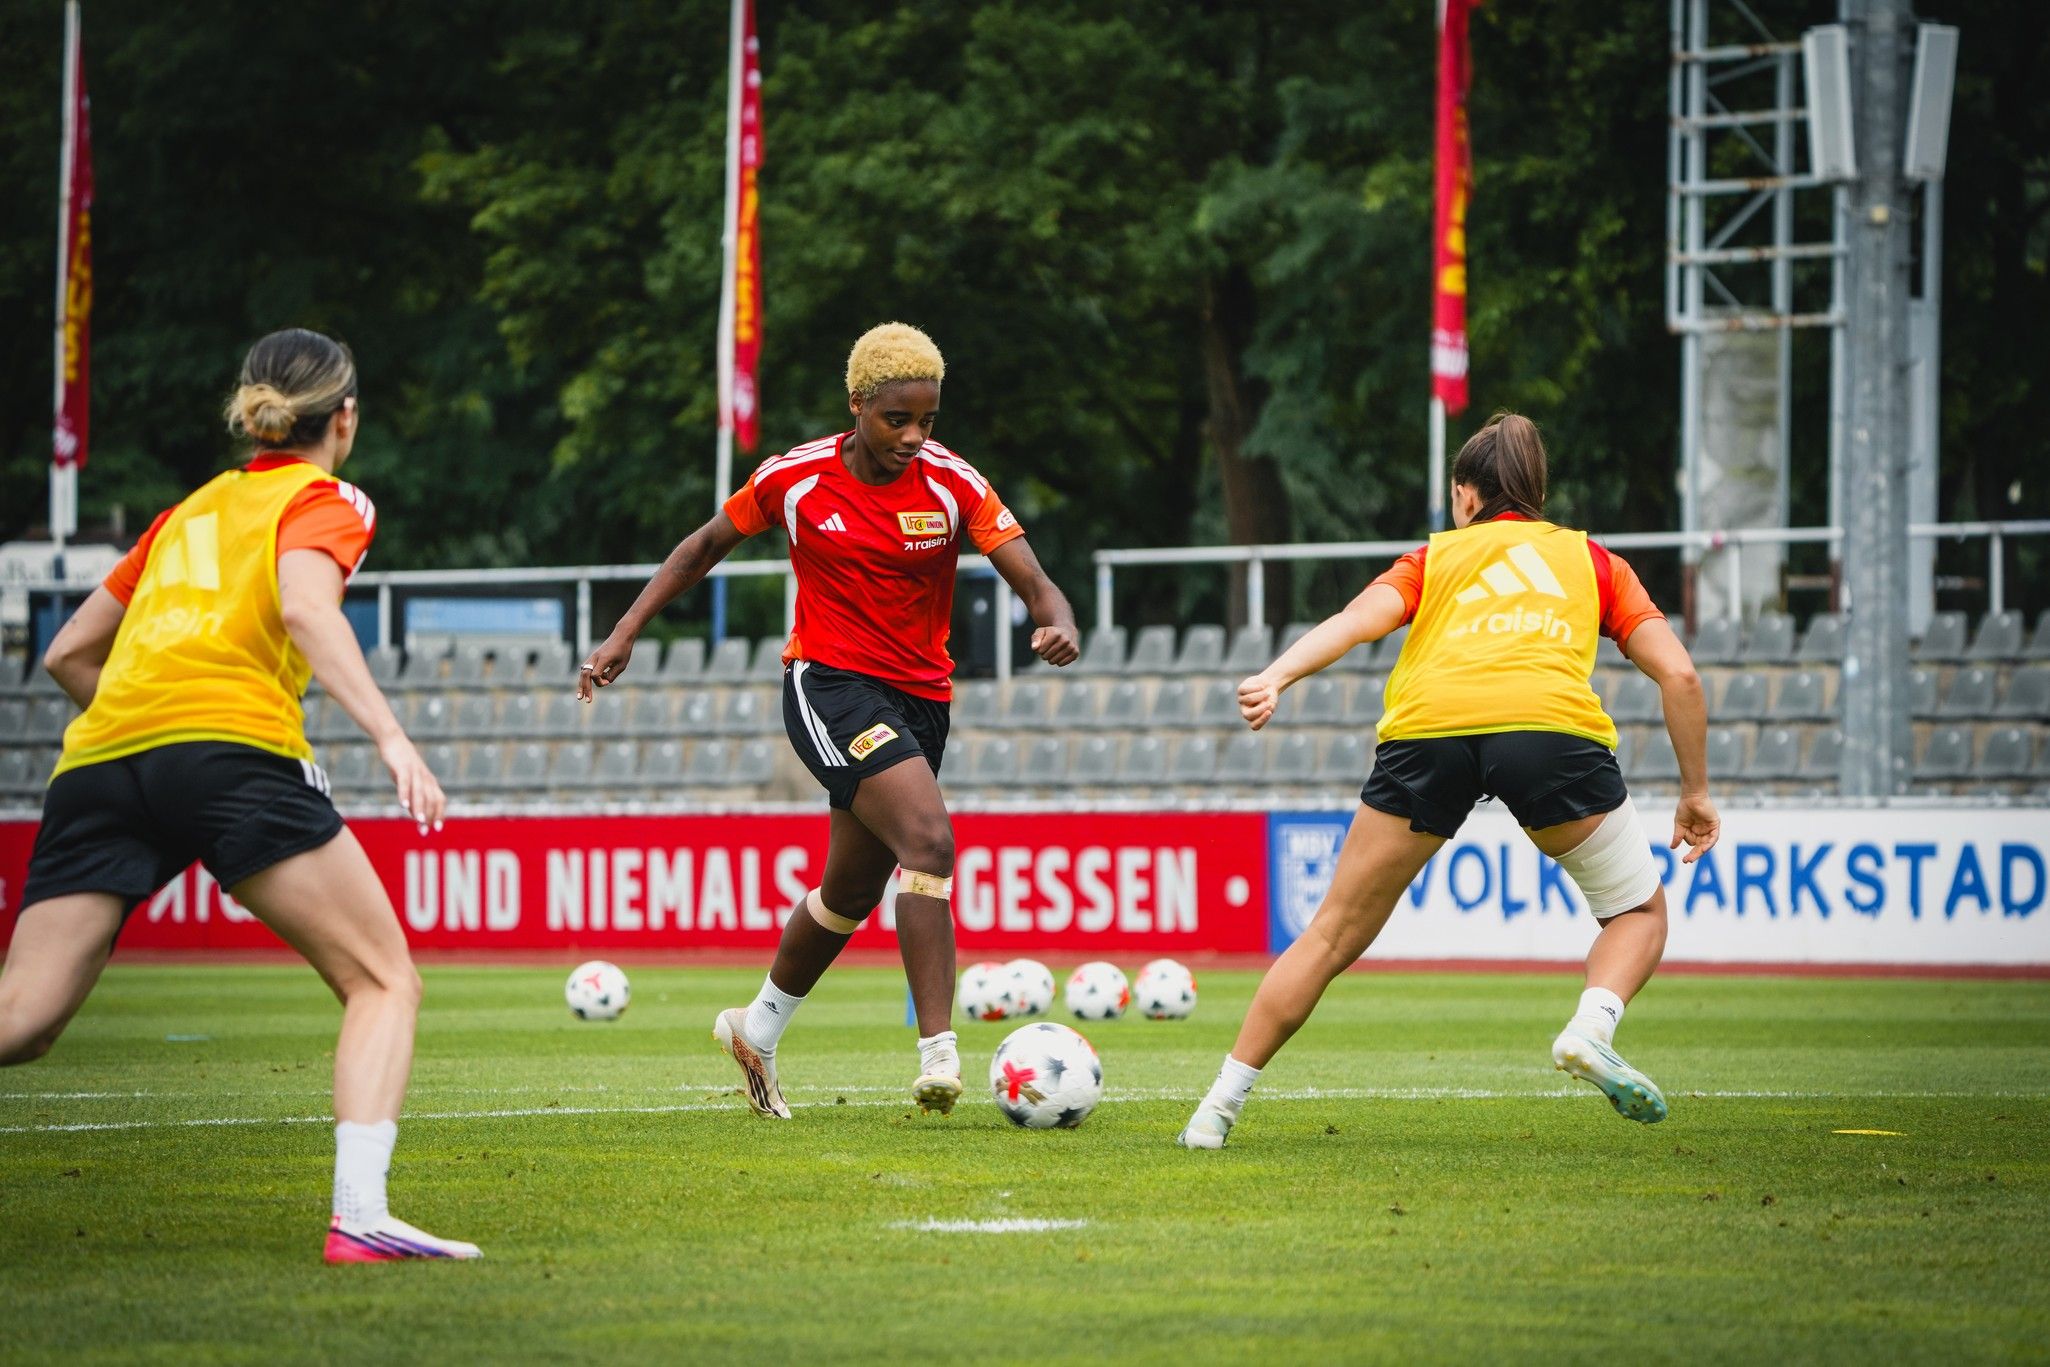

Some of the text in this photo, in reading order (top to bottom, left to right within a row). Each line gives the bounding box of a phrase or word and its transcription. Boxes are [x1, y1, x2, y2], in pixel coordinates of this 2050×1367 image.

[915, 536, 947, 551] raisin
[1471, 606, 1572, 644] raisin
[404, 849, 520, 931] UND
[547, 847, 808, 931] NIEMALS
[1409, 841, 2046, 921] VOLKPARKSTAD
